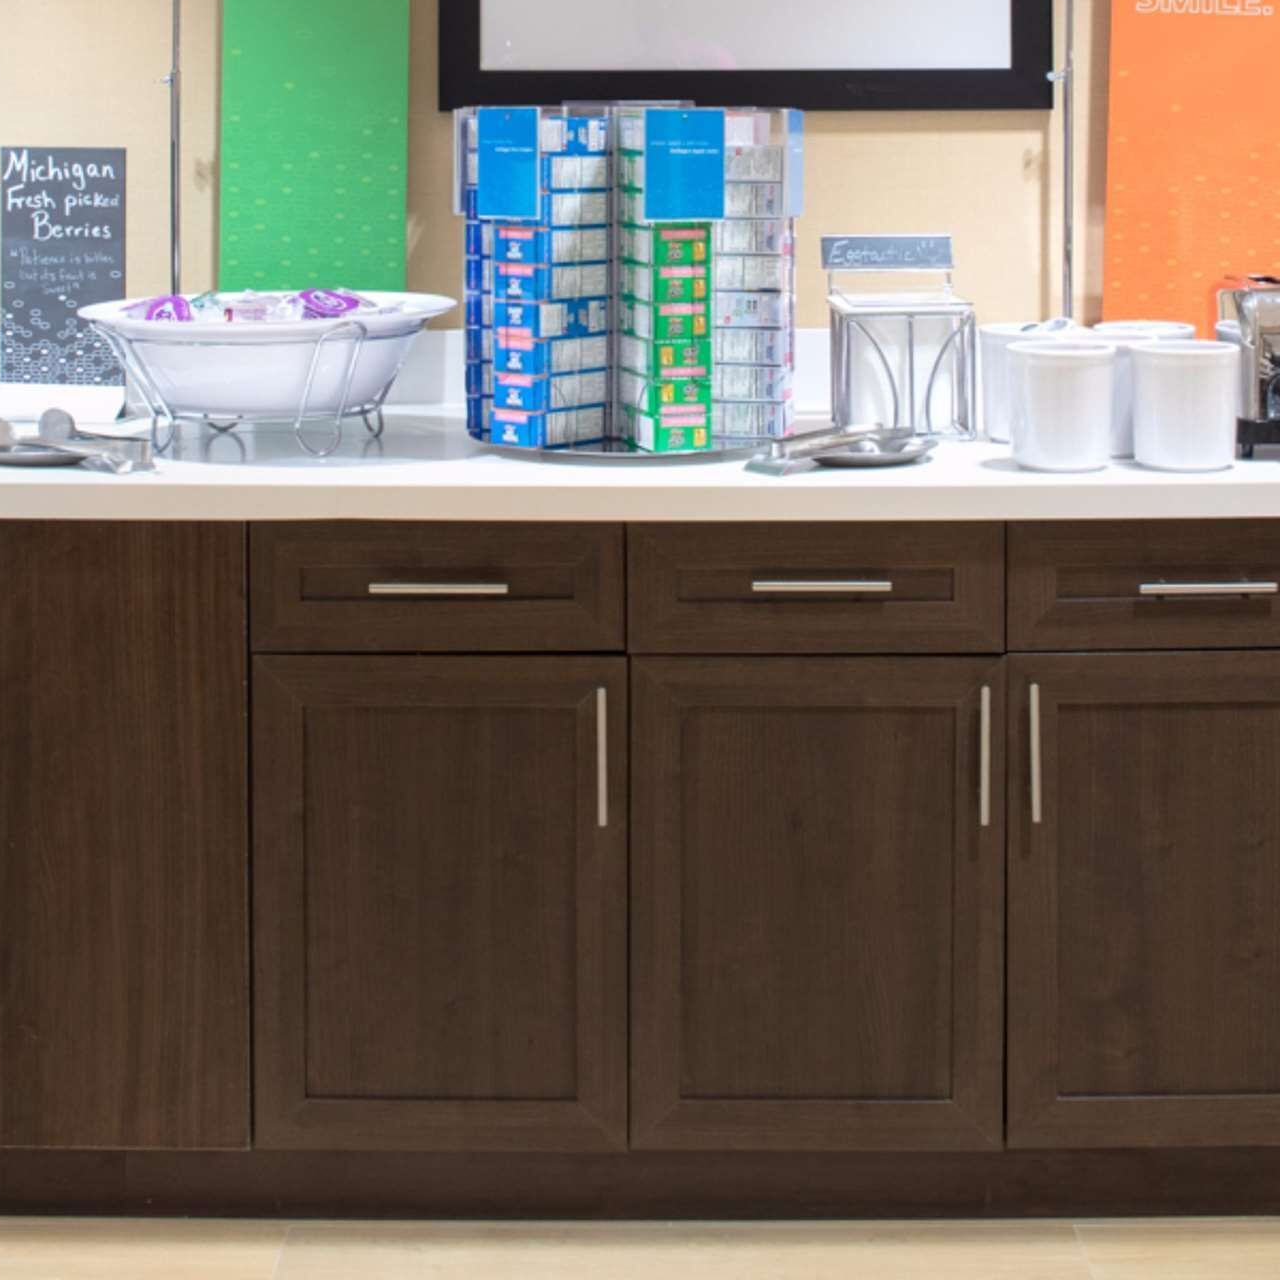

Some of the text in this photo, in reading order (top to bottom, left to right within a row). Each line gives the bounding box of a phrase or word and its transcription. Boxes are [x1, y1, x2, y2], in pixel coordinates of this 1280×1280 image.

[3, 148, 116, 191] Michigan
[6, 183, 57, 211] Fresh
[30, 209, 113, 241] Berries
